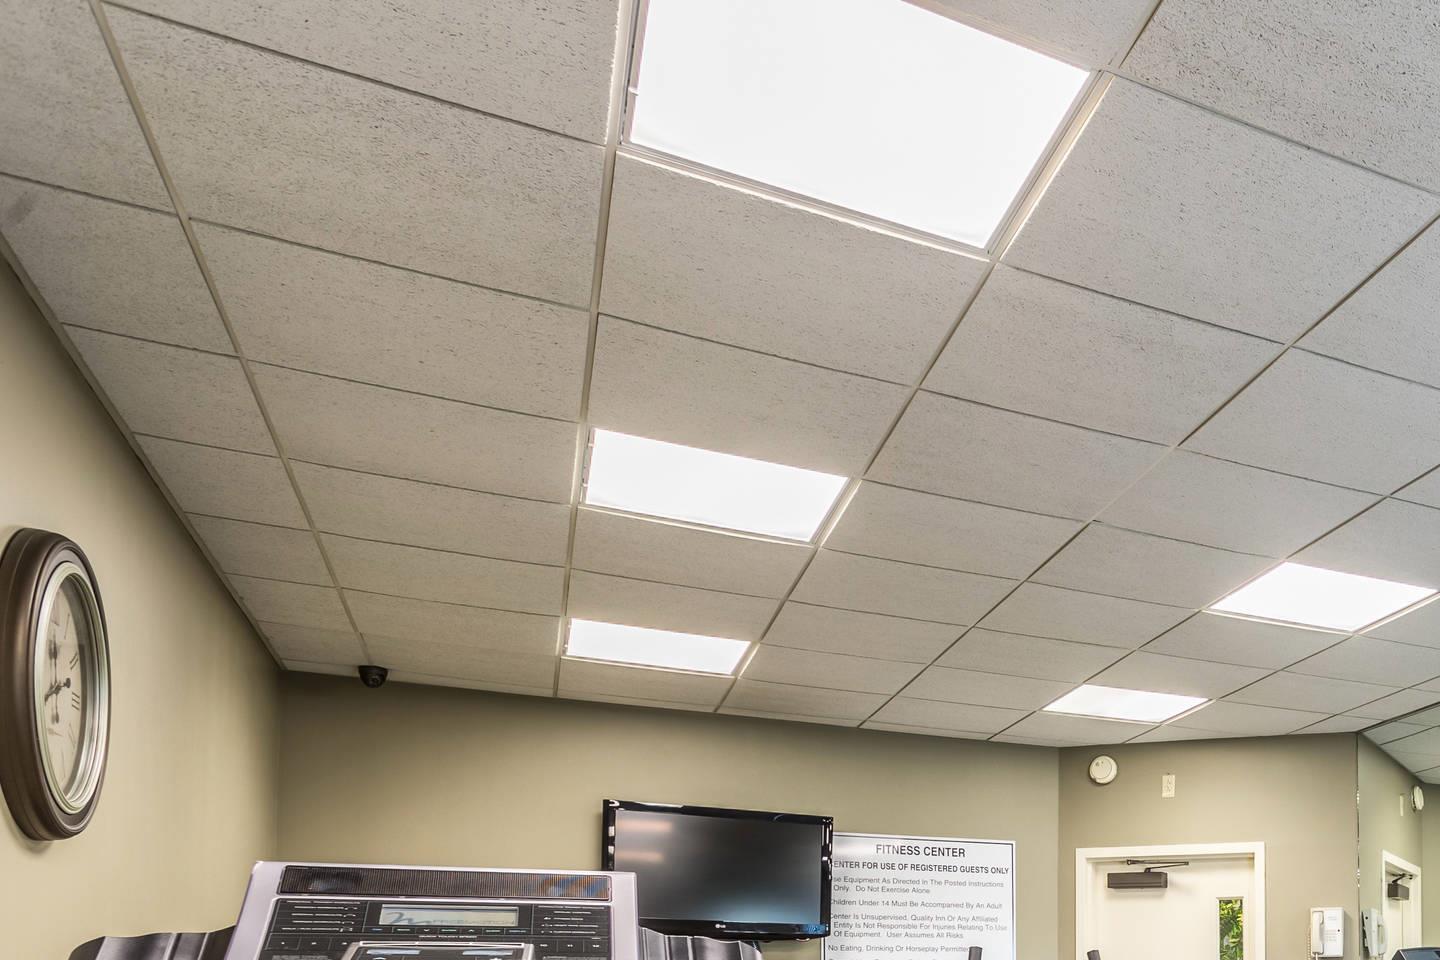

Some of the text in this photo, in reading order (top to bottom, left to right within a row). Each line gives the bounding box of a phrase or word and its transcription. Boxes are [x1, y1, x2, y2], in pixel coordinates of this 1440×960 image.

[876, 844, 966, 858] FITNESS CENTER
[832, 860, 1009, 875] ENTER FOR USE OF REGISTERED GUESTS ONLY
[843, 876, 880, 884] Equipment
[920, 901, 964, 909] Accompanied
[965, 902, 974, 910] By
[910, 914, 934, 922] Quality
[833, 921, 853, 929] Entity
[876, 922, 918, 930] Responsible
[932, 923, 956, 931] Injuries
[866, 945, 894, 953] Drinking
[905, 945, 939, 953] Horseplay
